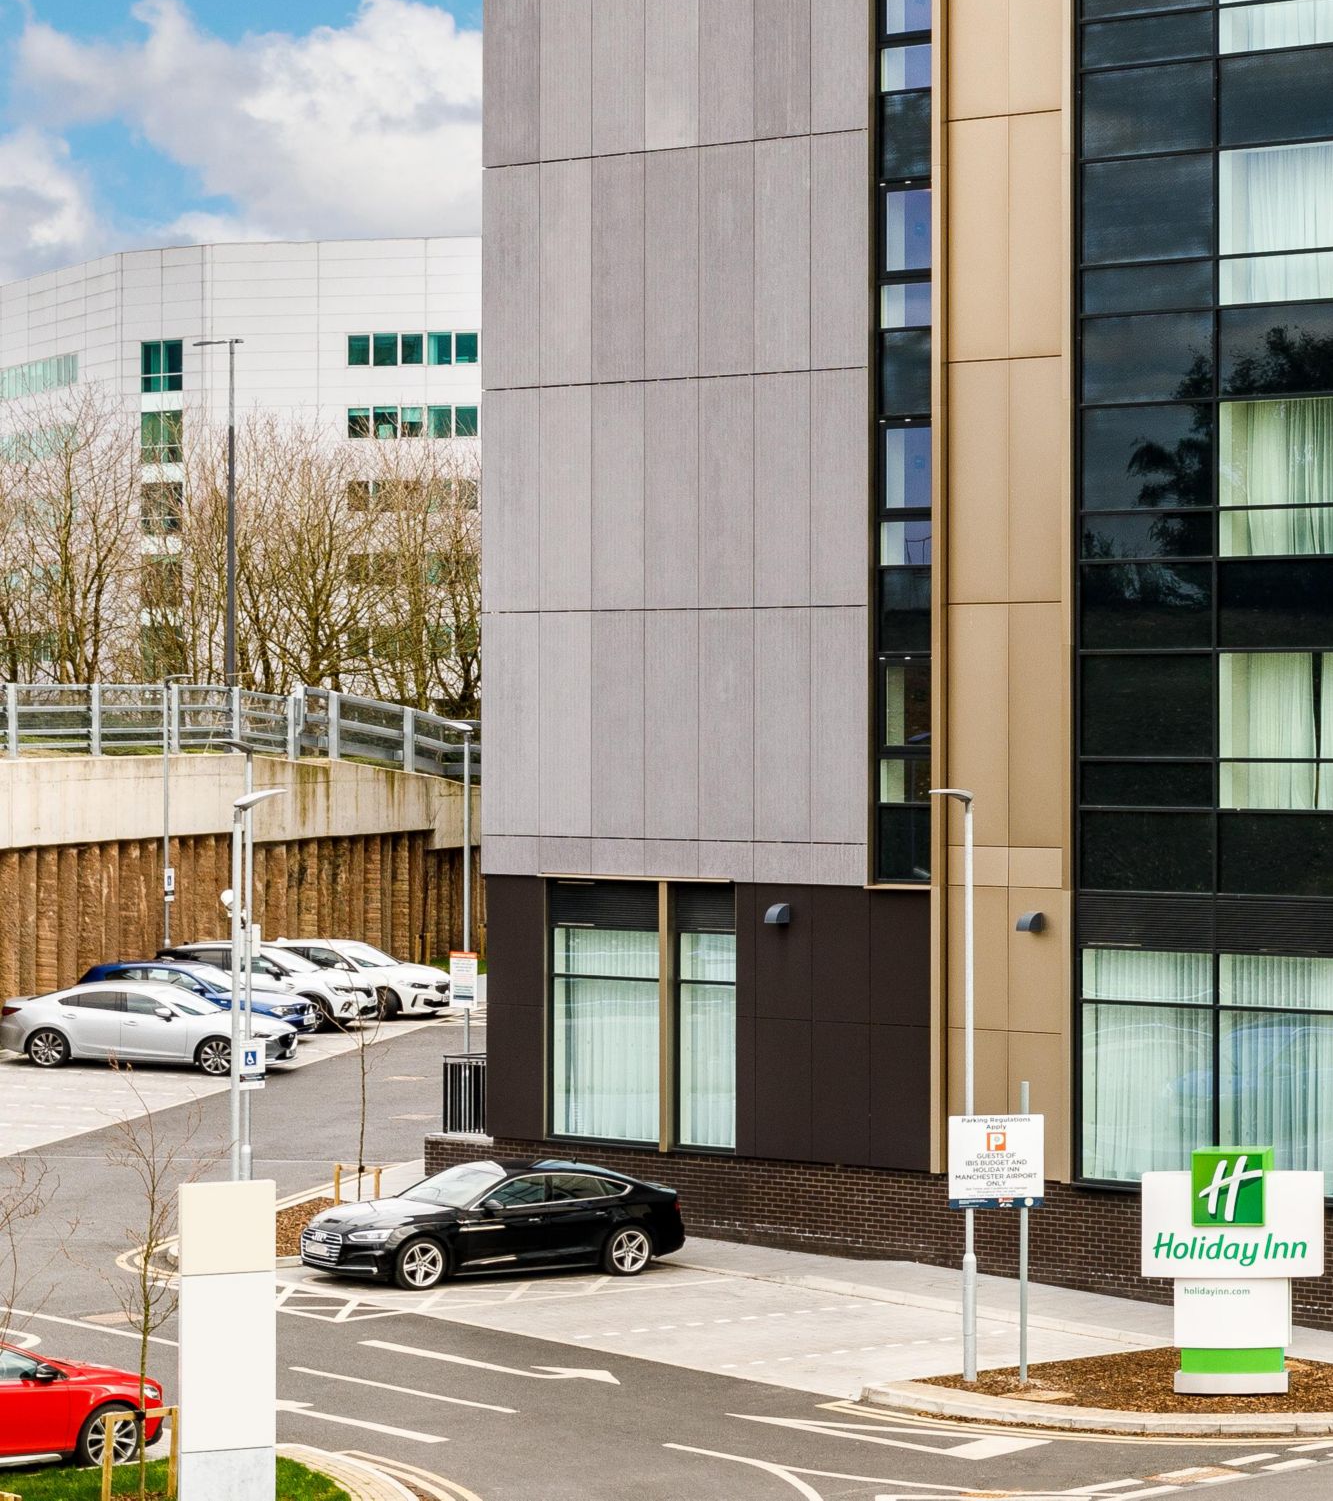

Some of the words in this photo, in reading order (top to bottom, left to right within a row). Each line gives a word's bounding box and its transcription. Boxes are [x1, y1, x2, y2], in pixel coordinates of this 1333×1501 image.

[989, 1133, 1005, 1151] P
[1153, 1232, 1259, 1267] Holiday
[1263, 1233, 1308, 1260] Inn
[1184, 1287, 1251, 1298] holidayinn.com
